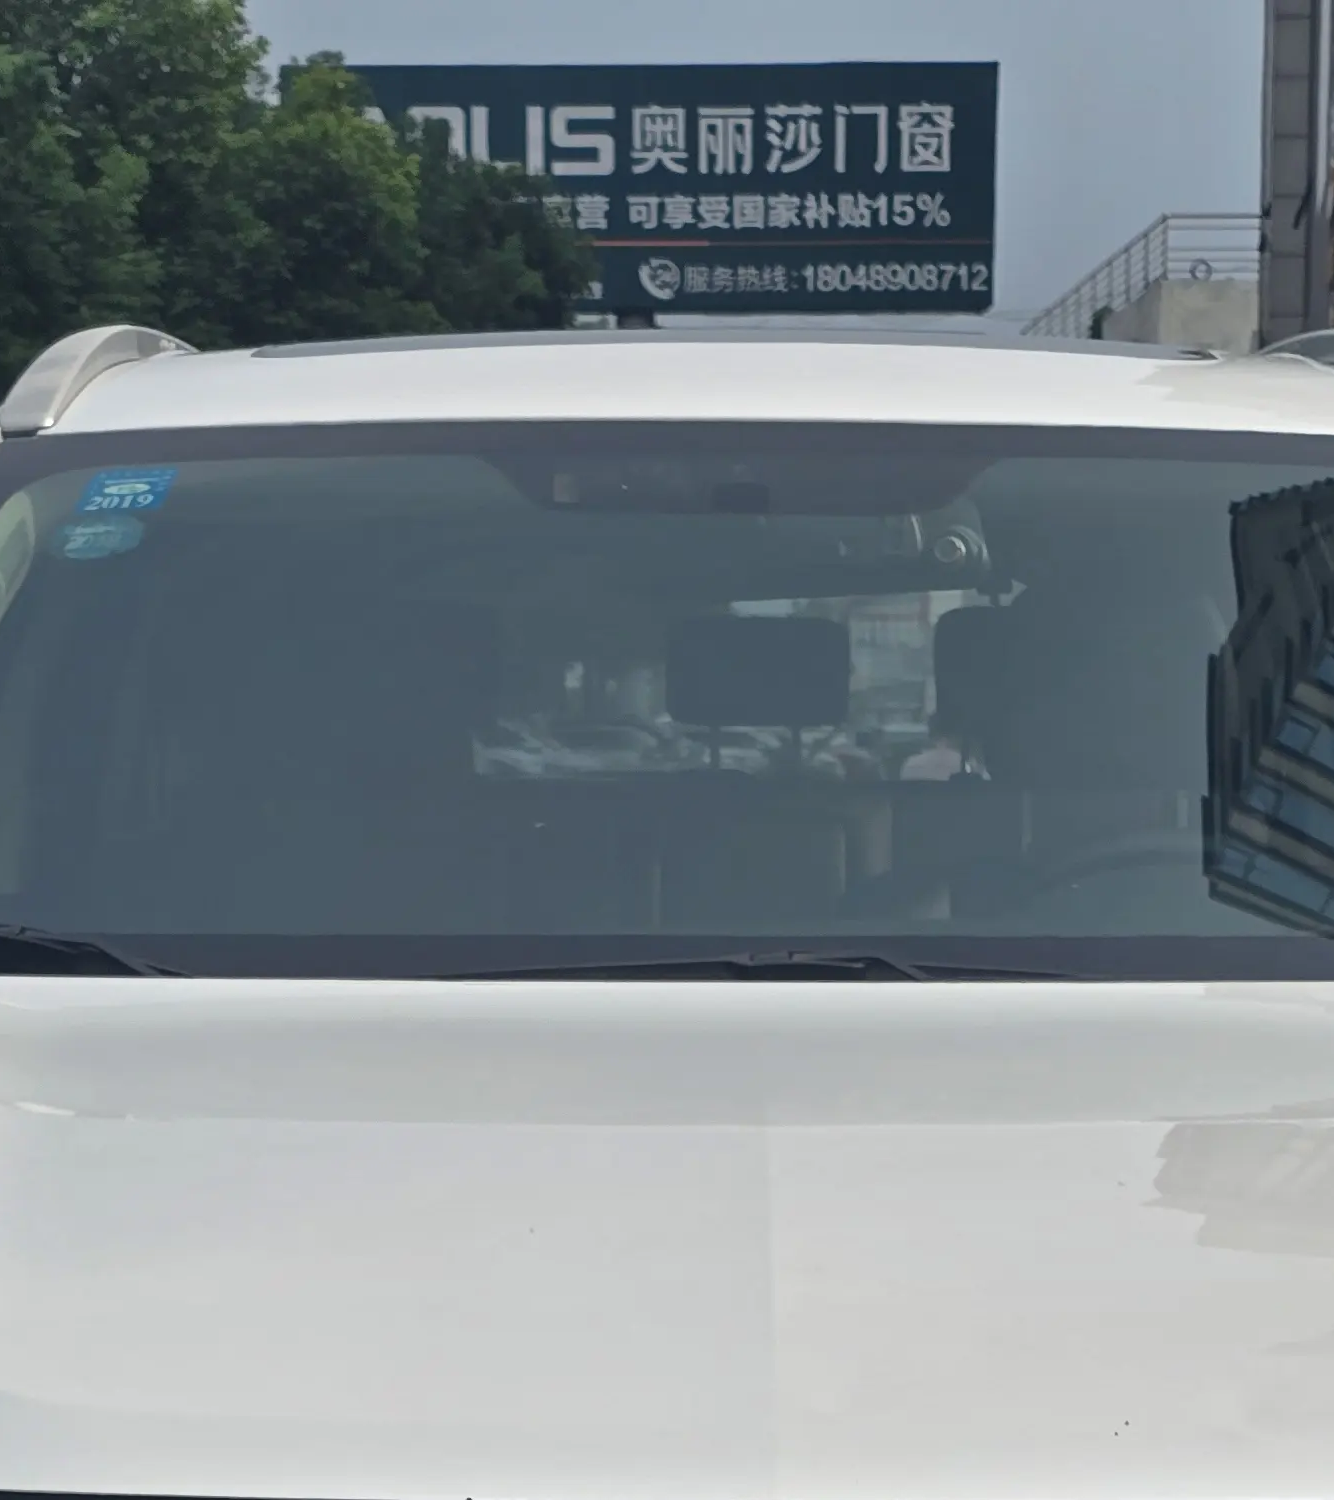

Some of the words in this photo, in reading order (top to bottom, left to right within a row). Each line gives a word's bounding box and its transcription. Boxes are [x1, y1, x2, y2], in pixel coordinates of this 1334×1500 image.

[630, 103, 955, 175] 奥丽莎门窗
[626, 192, 952, 229] 可享受国家补贴15%
[83, 493, 154, 511] 2019
